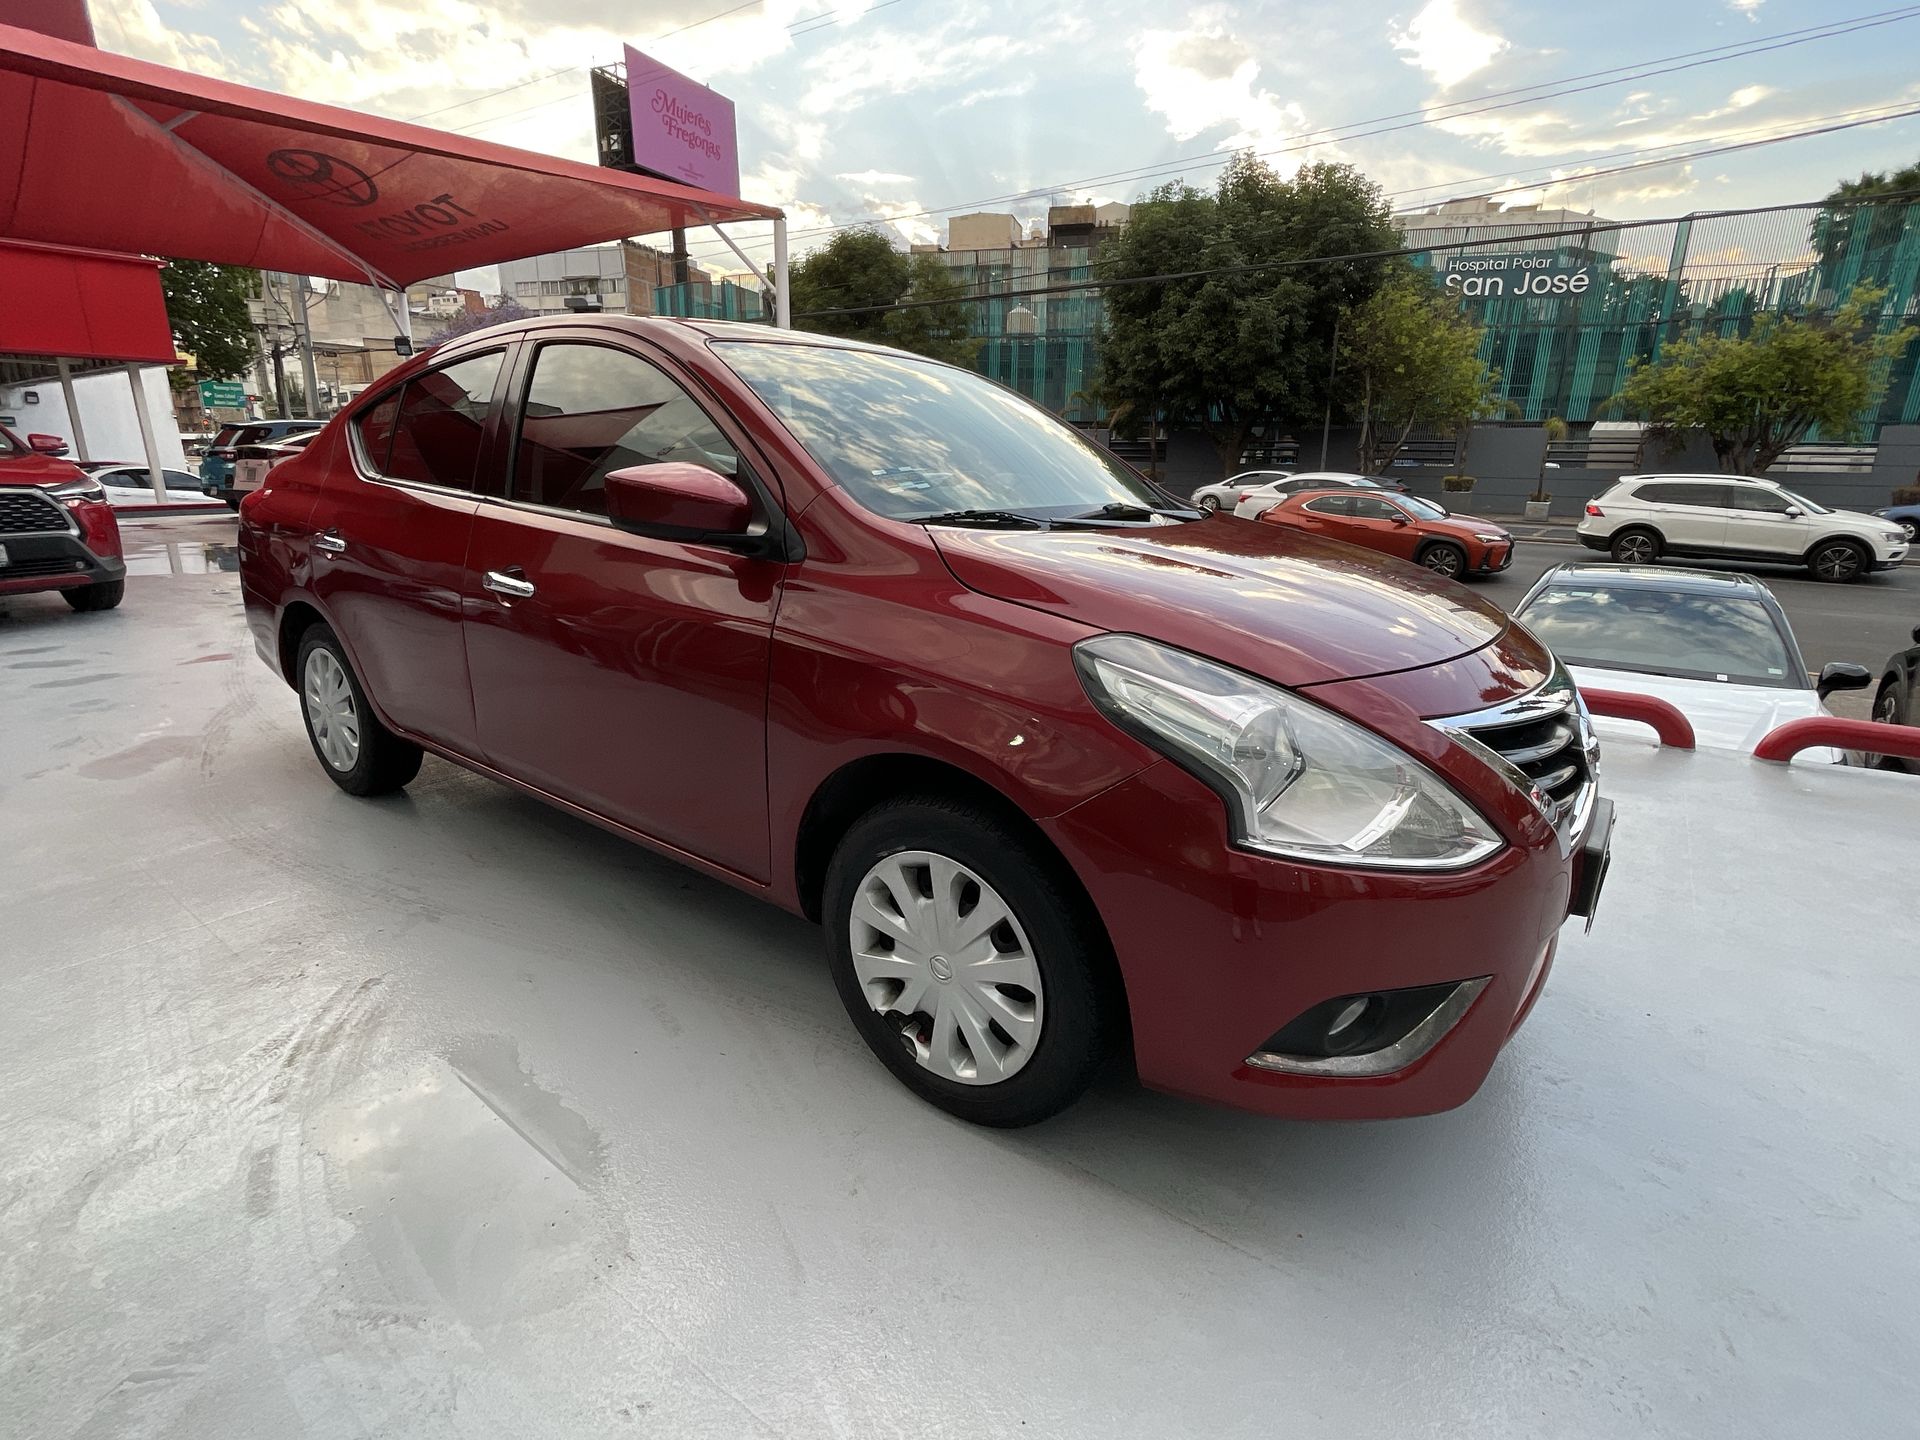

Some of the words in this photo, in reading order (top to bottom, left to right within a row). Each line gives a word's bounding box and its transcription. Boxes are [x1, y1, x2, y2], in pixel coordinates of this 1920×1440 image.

[651, 88, 712, 137] Mujeres
[662, 114, 721, 161] Fregonas
[1445, 274, 1504, 296] San
[1513, 267, 1590, 295] José
[1448, 258, 1508, 274] Hospital
[1512, 257, 1552, 269] Polar
